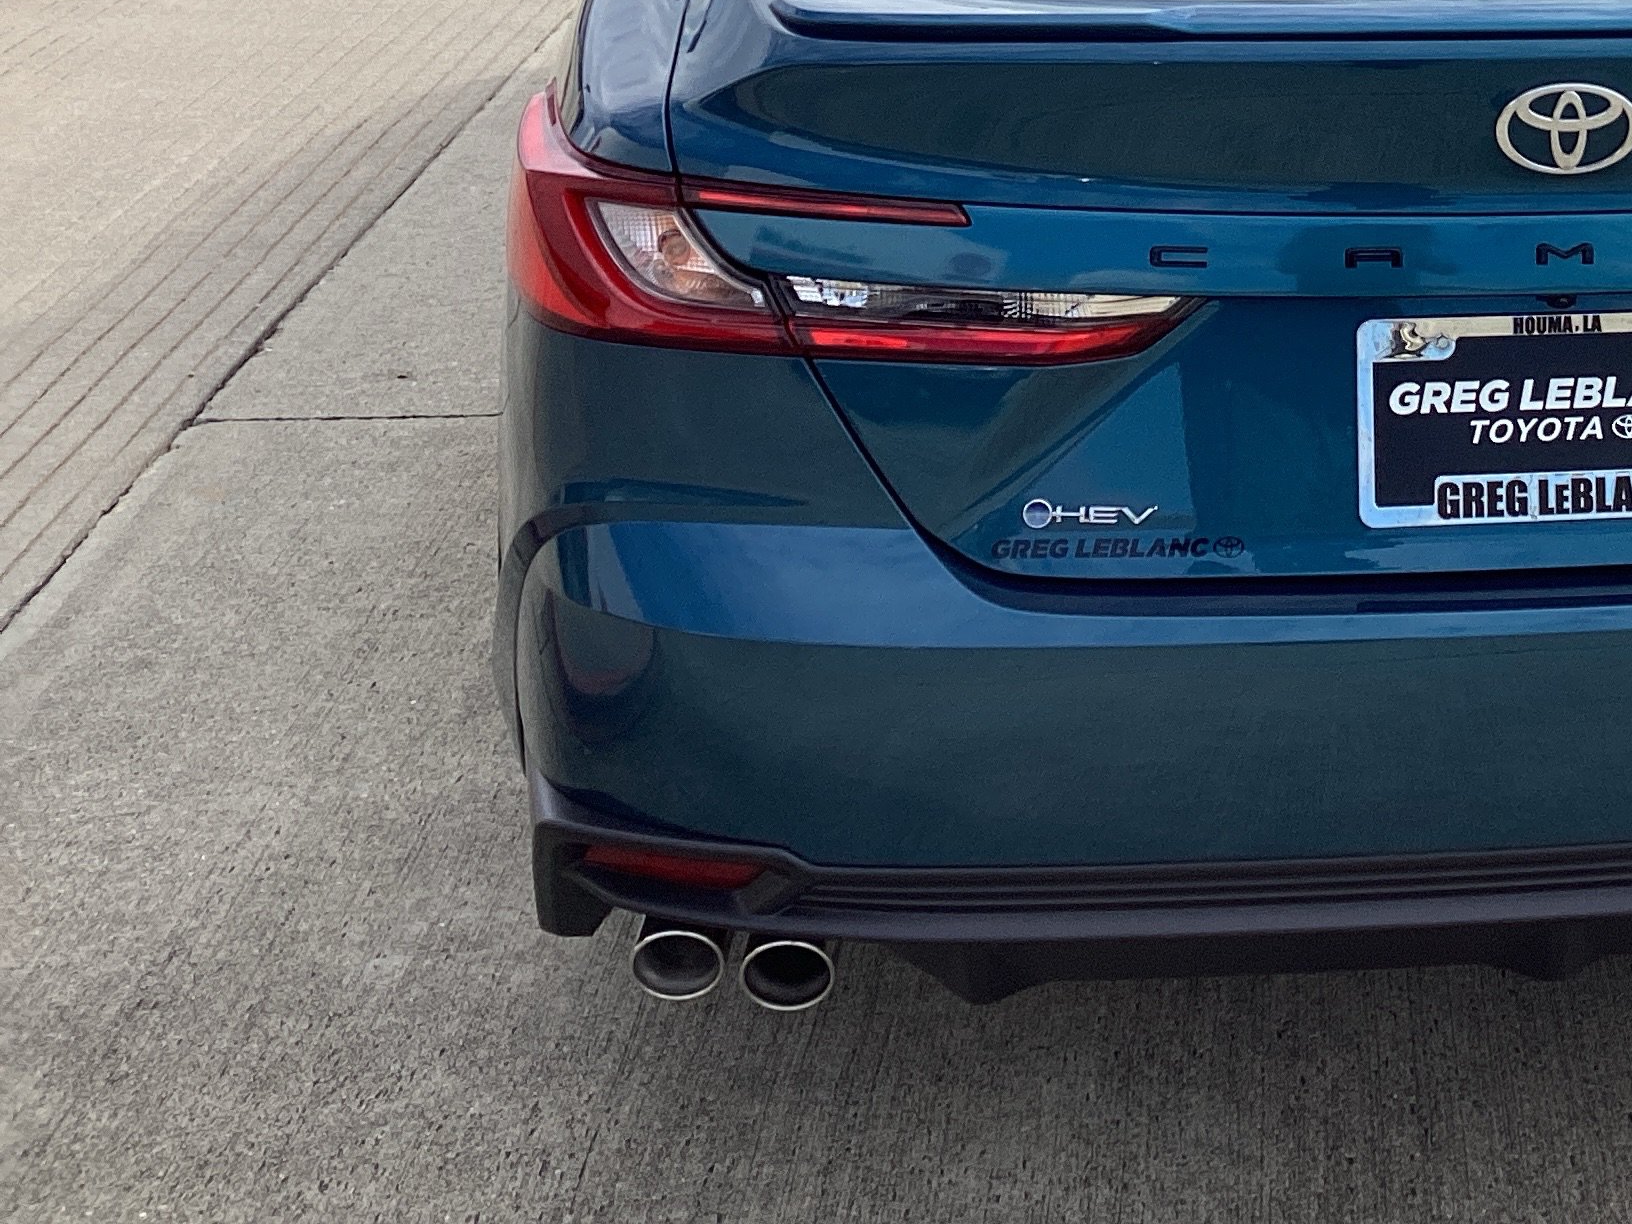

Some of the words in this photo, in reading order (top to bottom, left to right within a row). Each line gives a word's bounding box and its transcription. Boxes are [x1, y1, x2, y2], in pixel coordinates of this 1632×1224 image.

[1583, 314, 1602, 332] LA
[1389, 380, 1510, 416] GREG
[1469, 416, 1604, 445] TOYOTA
[1437, 481, 1529, 520] GREG
[991, 538, 1069, 560] GREG
[1074, 536, 1210, 559] LEBLANC
